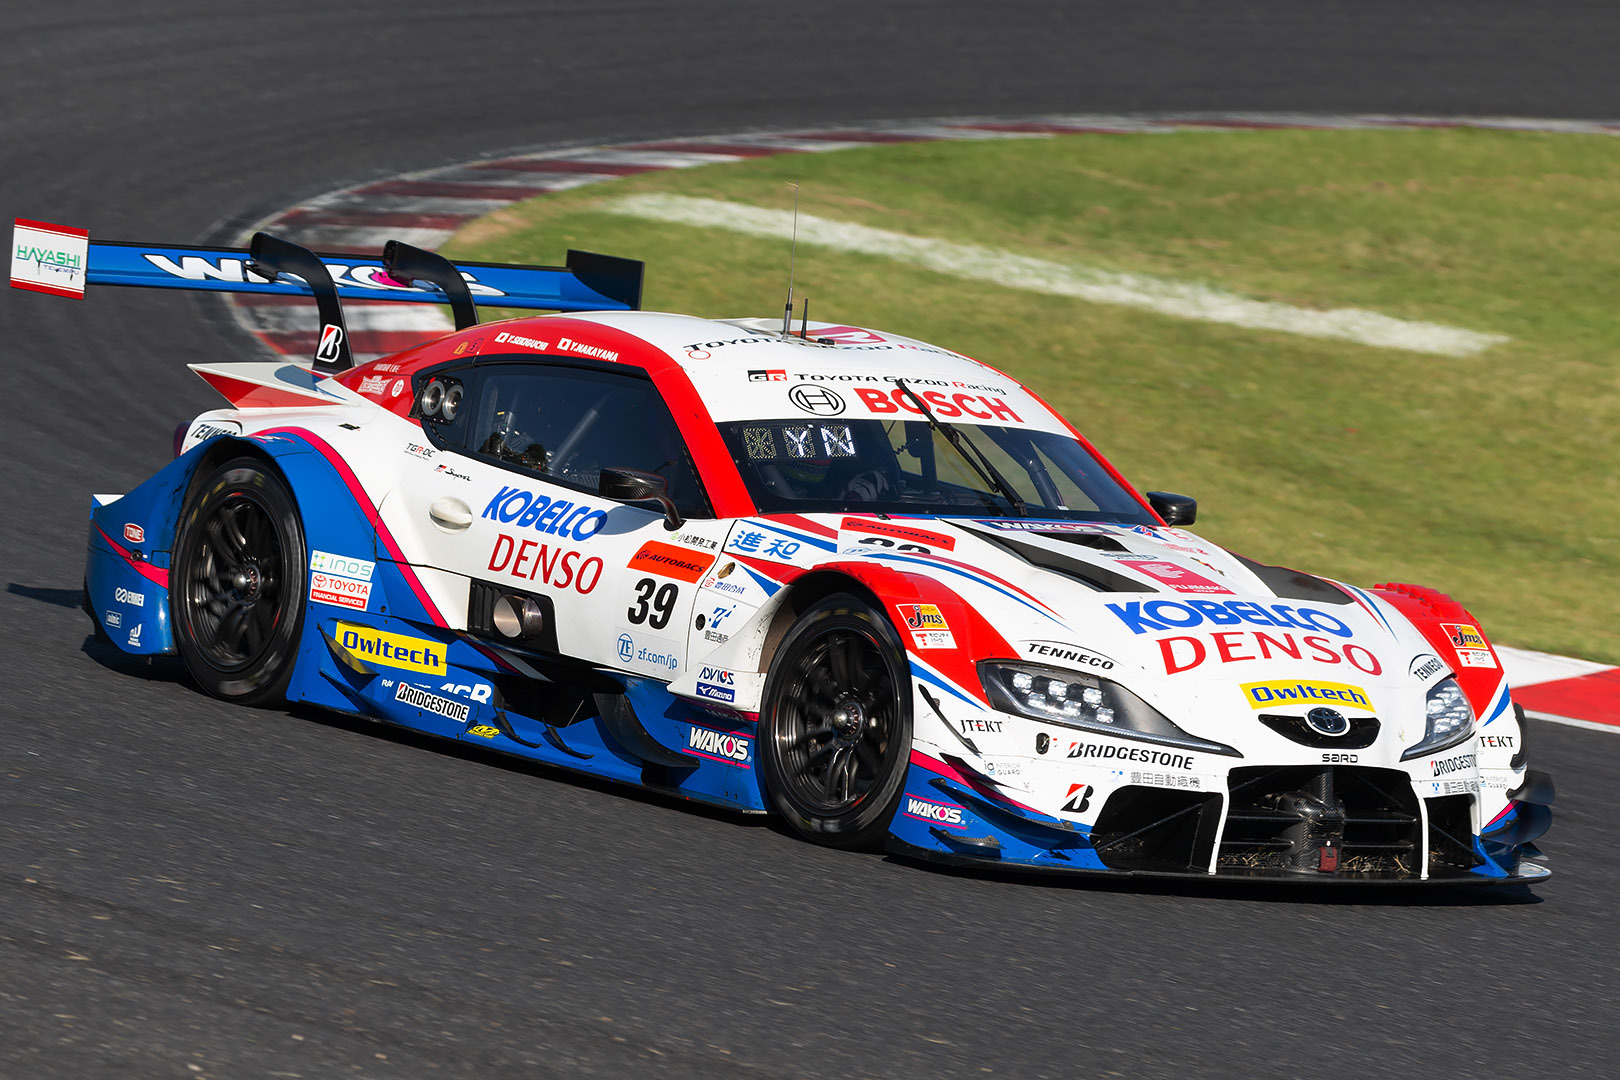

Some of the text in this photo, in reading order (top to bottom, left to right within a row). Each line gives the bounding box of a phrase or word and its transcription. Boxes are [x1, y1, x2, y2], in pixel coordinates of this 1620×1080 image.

[16, 244, 81, 268] HAYASHI
[570, 341, 619, 363] Y.NAKAYAMA
[794, 373, 1007, 395] TOYOTA GAZOO Racing
[853, 387, 1026, 424] BOSCH
[481, 485, 608, 542] KOBELCO
[728, 530, 801, 560] 進和
[487, 533, 604, 595] DENSO
[649, 553, 705, 574] AUTOBACS
[313, 591, 364, 607] FINANCIAL SERVICES
[329, 578, 368, 596] TOYOTA
[627, 577, 679, 630] 39
[1104, 600, 1353, 639] KOBELCO
[342, 630, 439, 668] Owltech
[638, 647, 678, 670] zf.com/jp
[1028, 642, 1115, 671] TENNECO
[1155, 631, 1383, 676] DENSO
[396, 683, 470, 722] BRIDGESTONE
[1251, 684, 1368, 706] Owltech
[960, 718, 1003, 734] JTEKT
[1066, 741, 1195, 771] BRIDGESTONE
